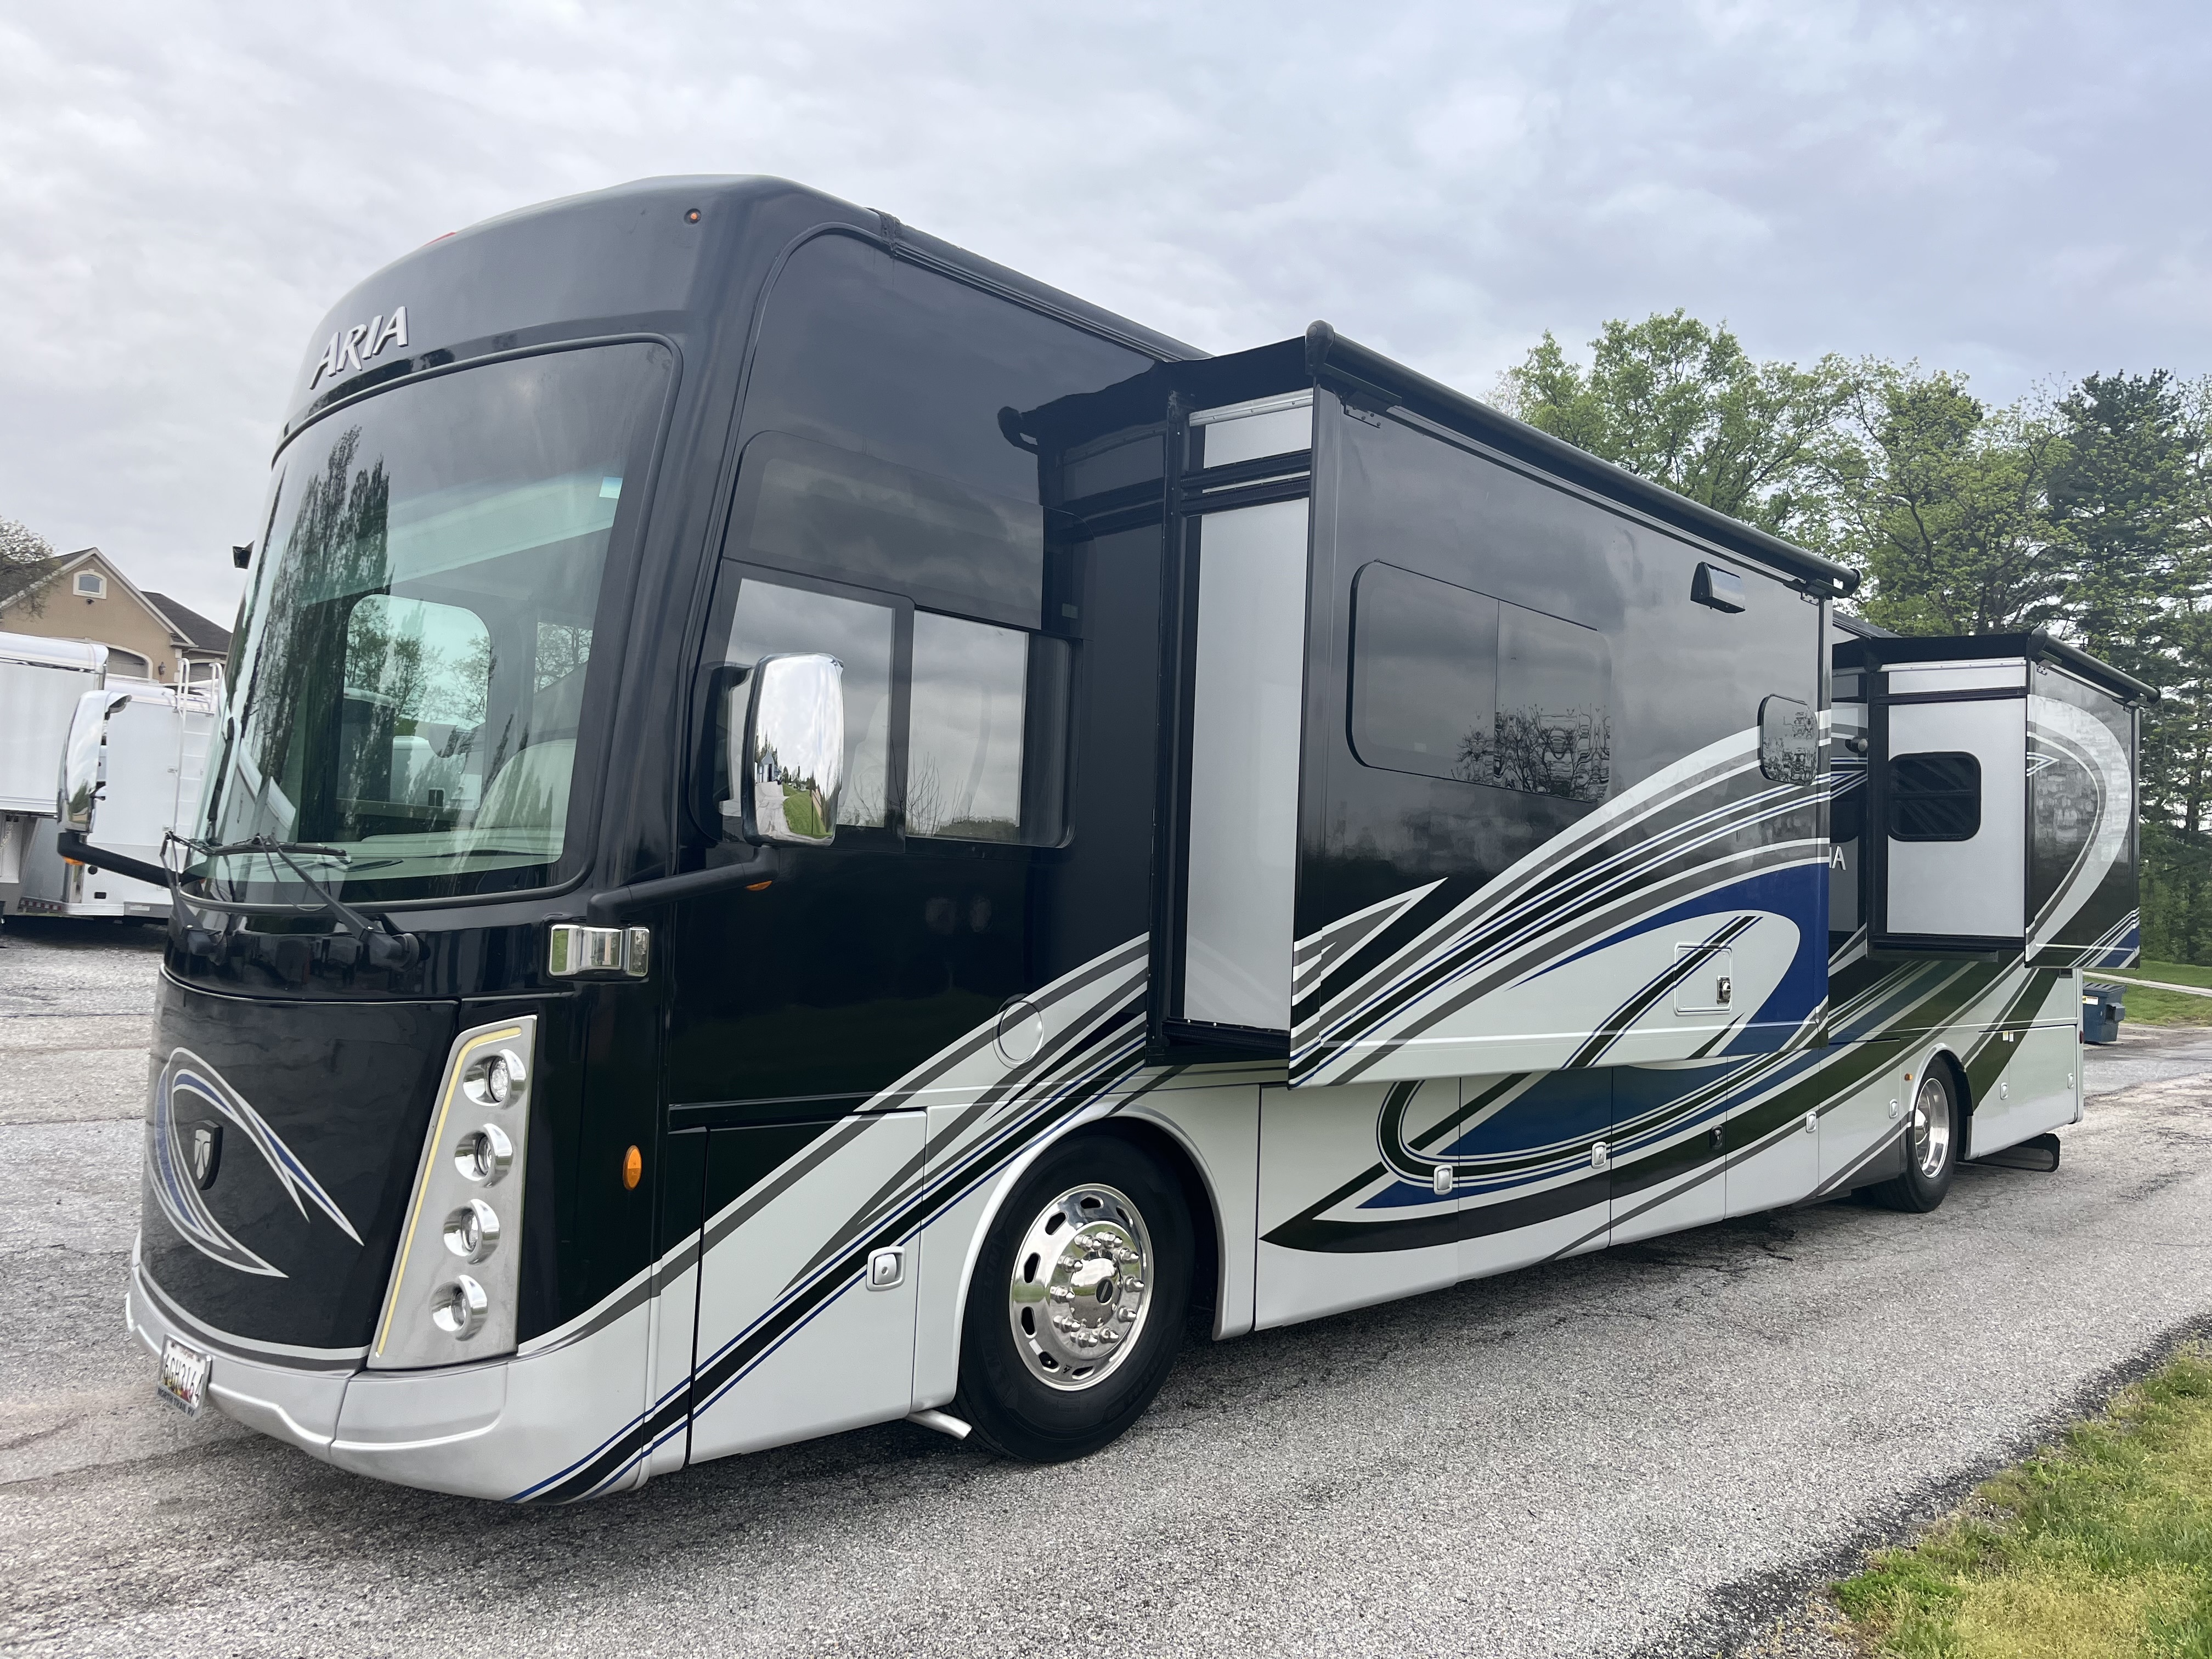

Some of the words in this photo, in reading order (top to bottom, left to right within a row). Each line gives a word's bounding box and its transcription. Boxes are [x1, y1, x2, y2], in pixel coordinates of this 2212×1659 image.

[309, 306, 409, 390] ARIA
[174, 1398, 186, 1413] TRAIL
[187, 1406, 195, 1418] RV
